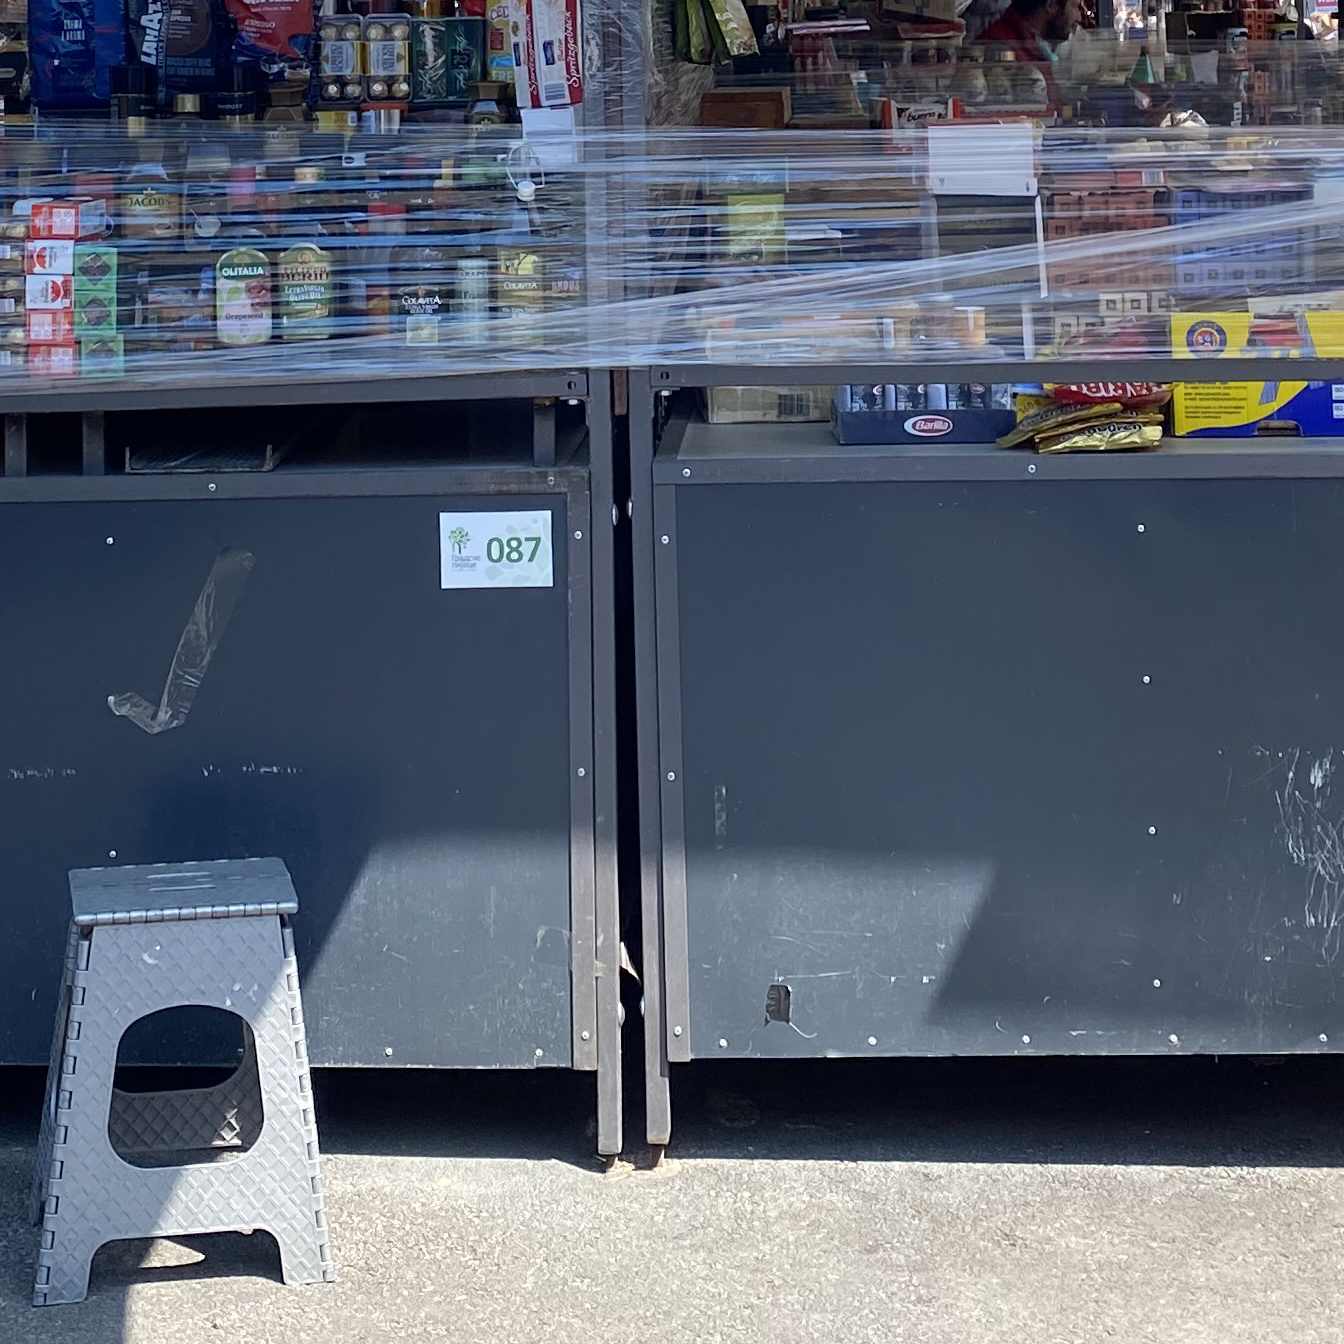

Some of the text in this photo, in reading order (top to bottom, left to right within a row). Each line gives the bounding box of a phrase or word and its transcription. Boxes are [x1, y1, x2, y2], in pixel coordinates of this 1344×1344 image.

[129, 197, 169, 207] JACOBS
[222, 266, 264, 276] OLITALIA
[503, 282, 538, 290] COLAVITA
[401, 295, 442, 305] COLAVITA
[916, 420, 949, 431] Barilla
[486, 536, 542, 563] 087
